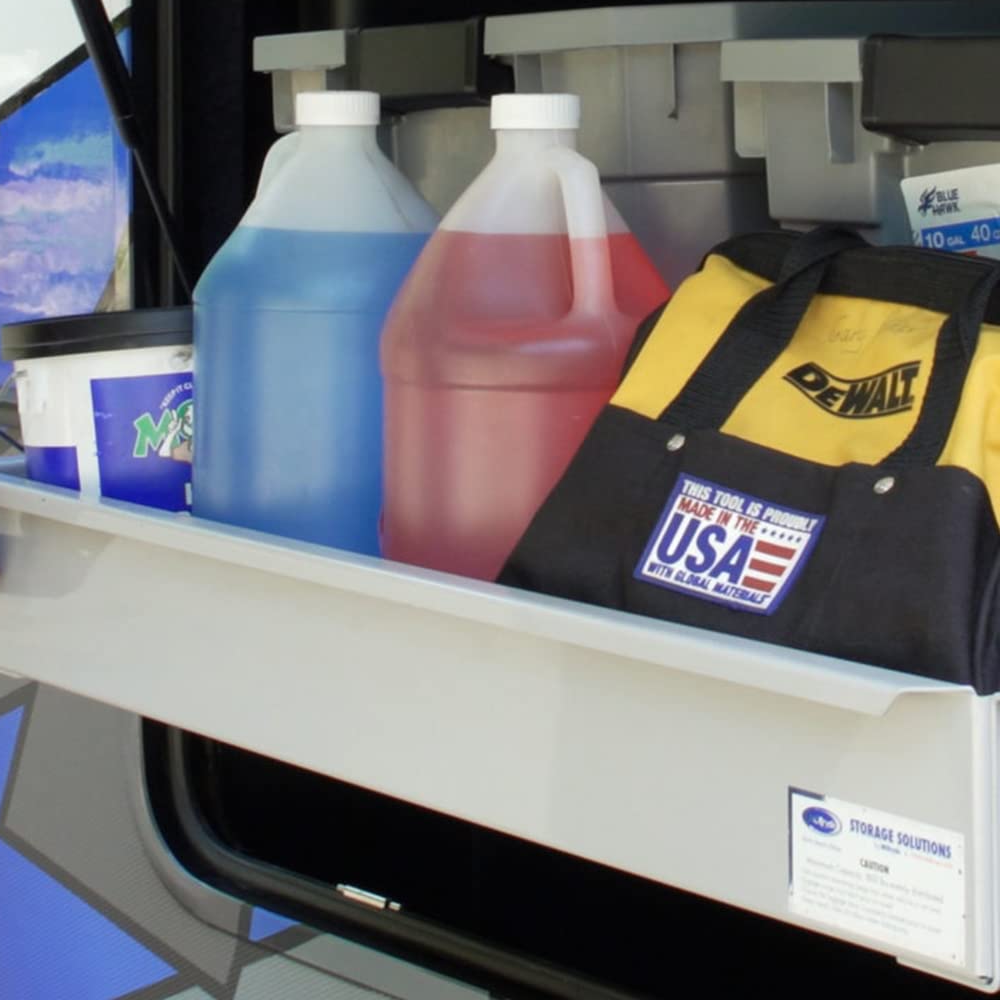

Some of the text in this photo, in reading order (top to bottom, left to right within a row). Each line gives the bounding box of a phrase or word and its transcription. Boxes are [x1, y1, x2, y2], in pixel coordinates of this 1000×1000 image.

[936, 188, 959, 202] BLUE
[925, 231, 945, 248] 10
[971, 224, 990, 242] 40
[785, 361, 920, 416] DEWALT
[677, 497, 761, 534] MADE IN THE
[681, 479, 819, 531] THIS TOOL IS PROUDLY
[656, 512, 755, 584] USA
[647, 562, 771, 605] WITH GLOBAL MATERIALS
[850, 818, 893, 843] STORAGE
[897, 832, 952, 859] SOLUTIONS
[859, 858, 890, 875] CAUTION
